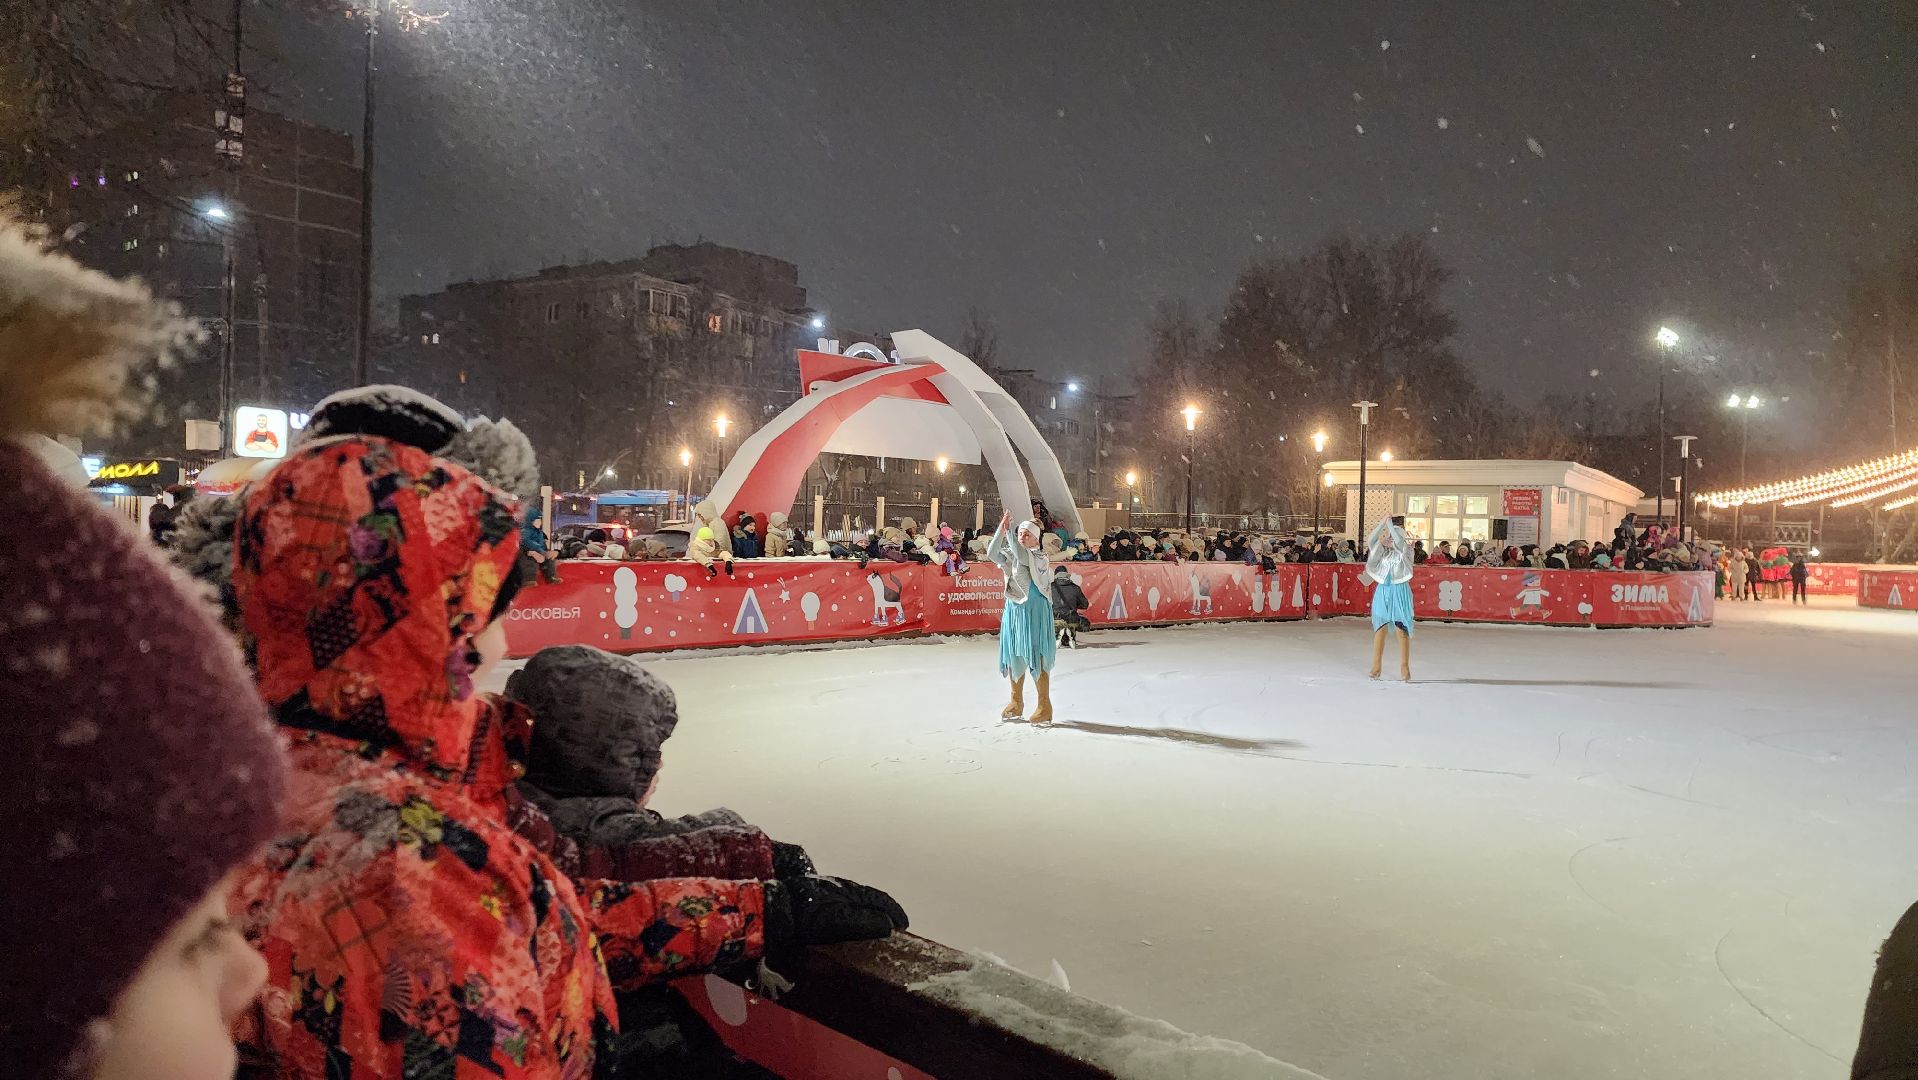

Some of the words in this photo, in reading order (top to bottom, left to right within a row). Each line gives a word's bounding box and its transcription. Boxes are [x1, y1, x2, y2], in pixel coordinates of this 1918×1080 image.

[955, 576, 1003, 588] Катайтесь
[939, 593, 945, 601] с
[1611, 584, 1669, 602] ЗИМА
[507, 607, 580, 620] ОСКОВЬЯ
